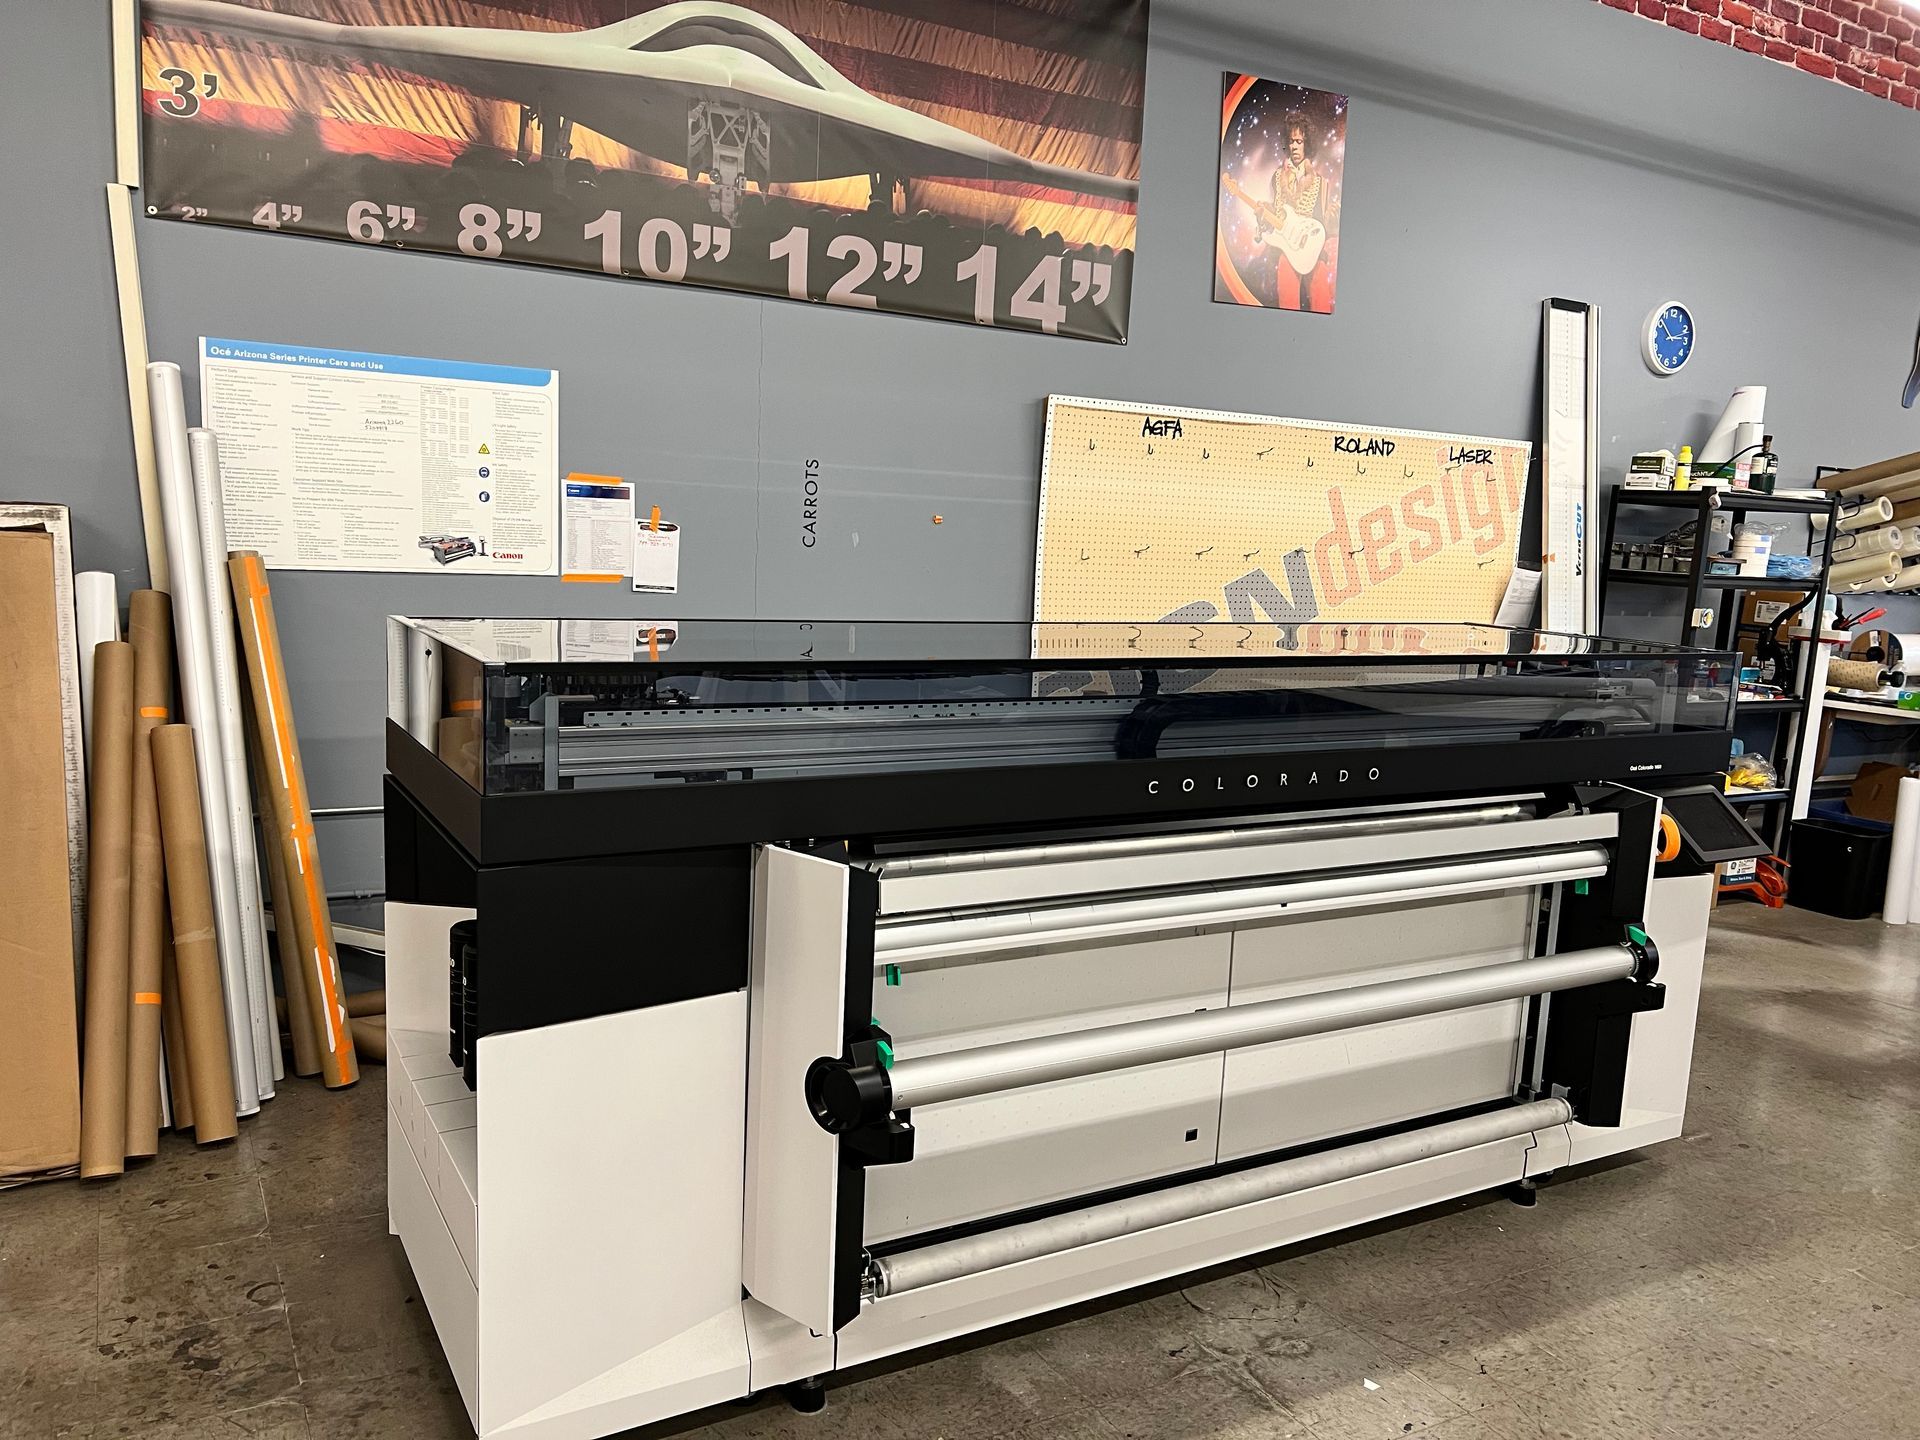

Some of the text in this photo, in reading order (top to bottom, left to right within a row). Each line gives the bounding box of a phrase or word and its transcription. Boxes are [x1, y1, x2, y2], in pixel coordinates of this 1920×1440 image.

[157, 67, 219, 118] 3'
[1670, 308, 1678, 318] 12
[1682, 325, 1689, 333] 2
[1682, 337, 1688, 346] 3
[210, 345, 384, 370] Océ Arizona Series Printer Care and Use
[1678, 348, 1684, 357] 4
[1663, 357, 1670, 367] 6
[1672, 356, 1678, 365] 5
[1142, 416, 1183, 440] AGFA
[1334, 436, 1395, 457] ROLAND
[1450, 446, 1493, 465] LASER
[802, 459, 819, 548] CARROTS
[492, 552, 523, 560] Canon
[1148, 767, 1380, 794] COLORADO
